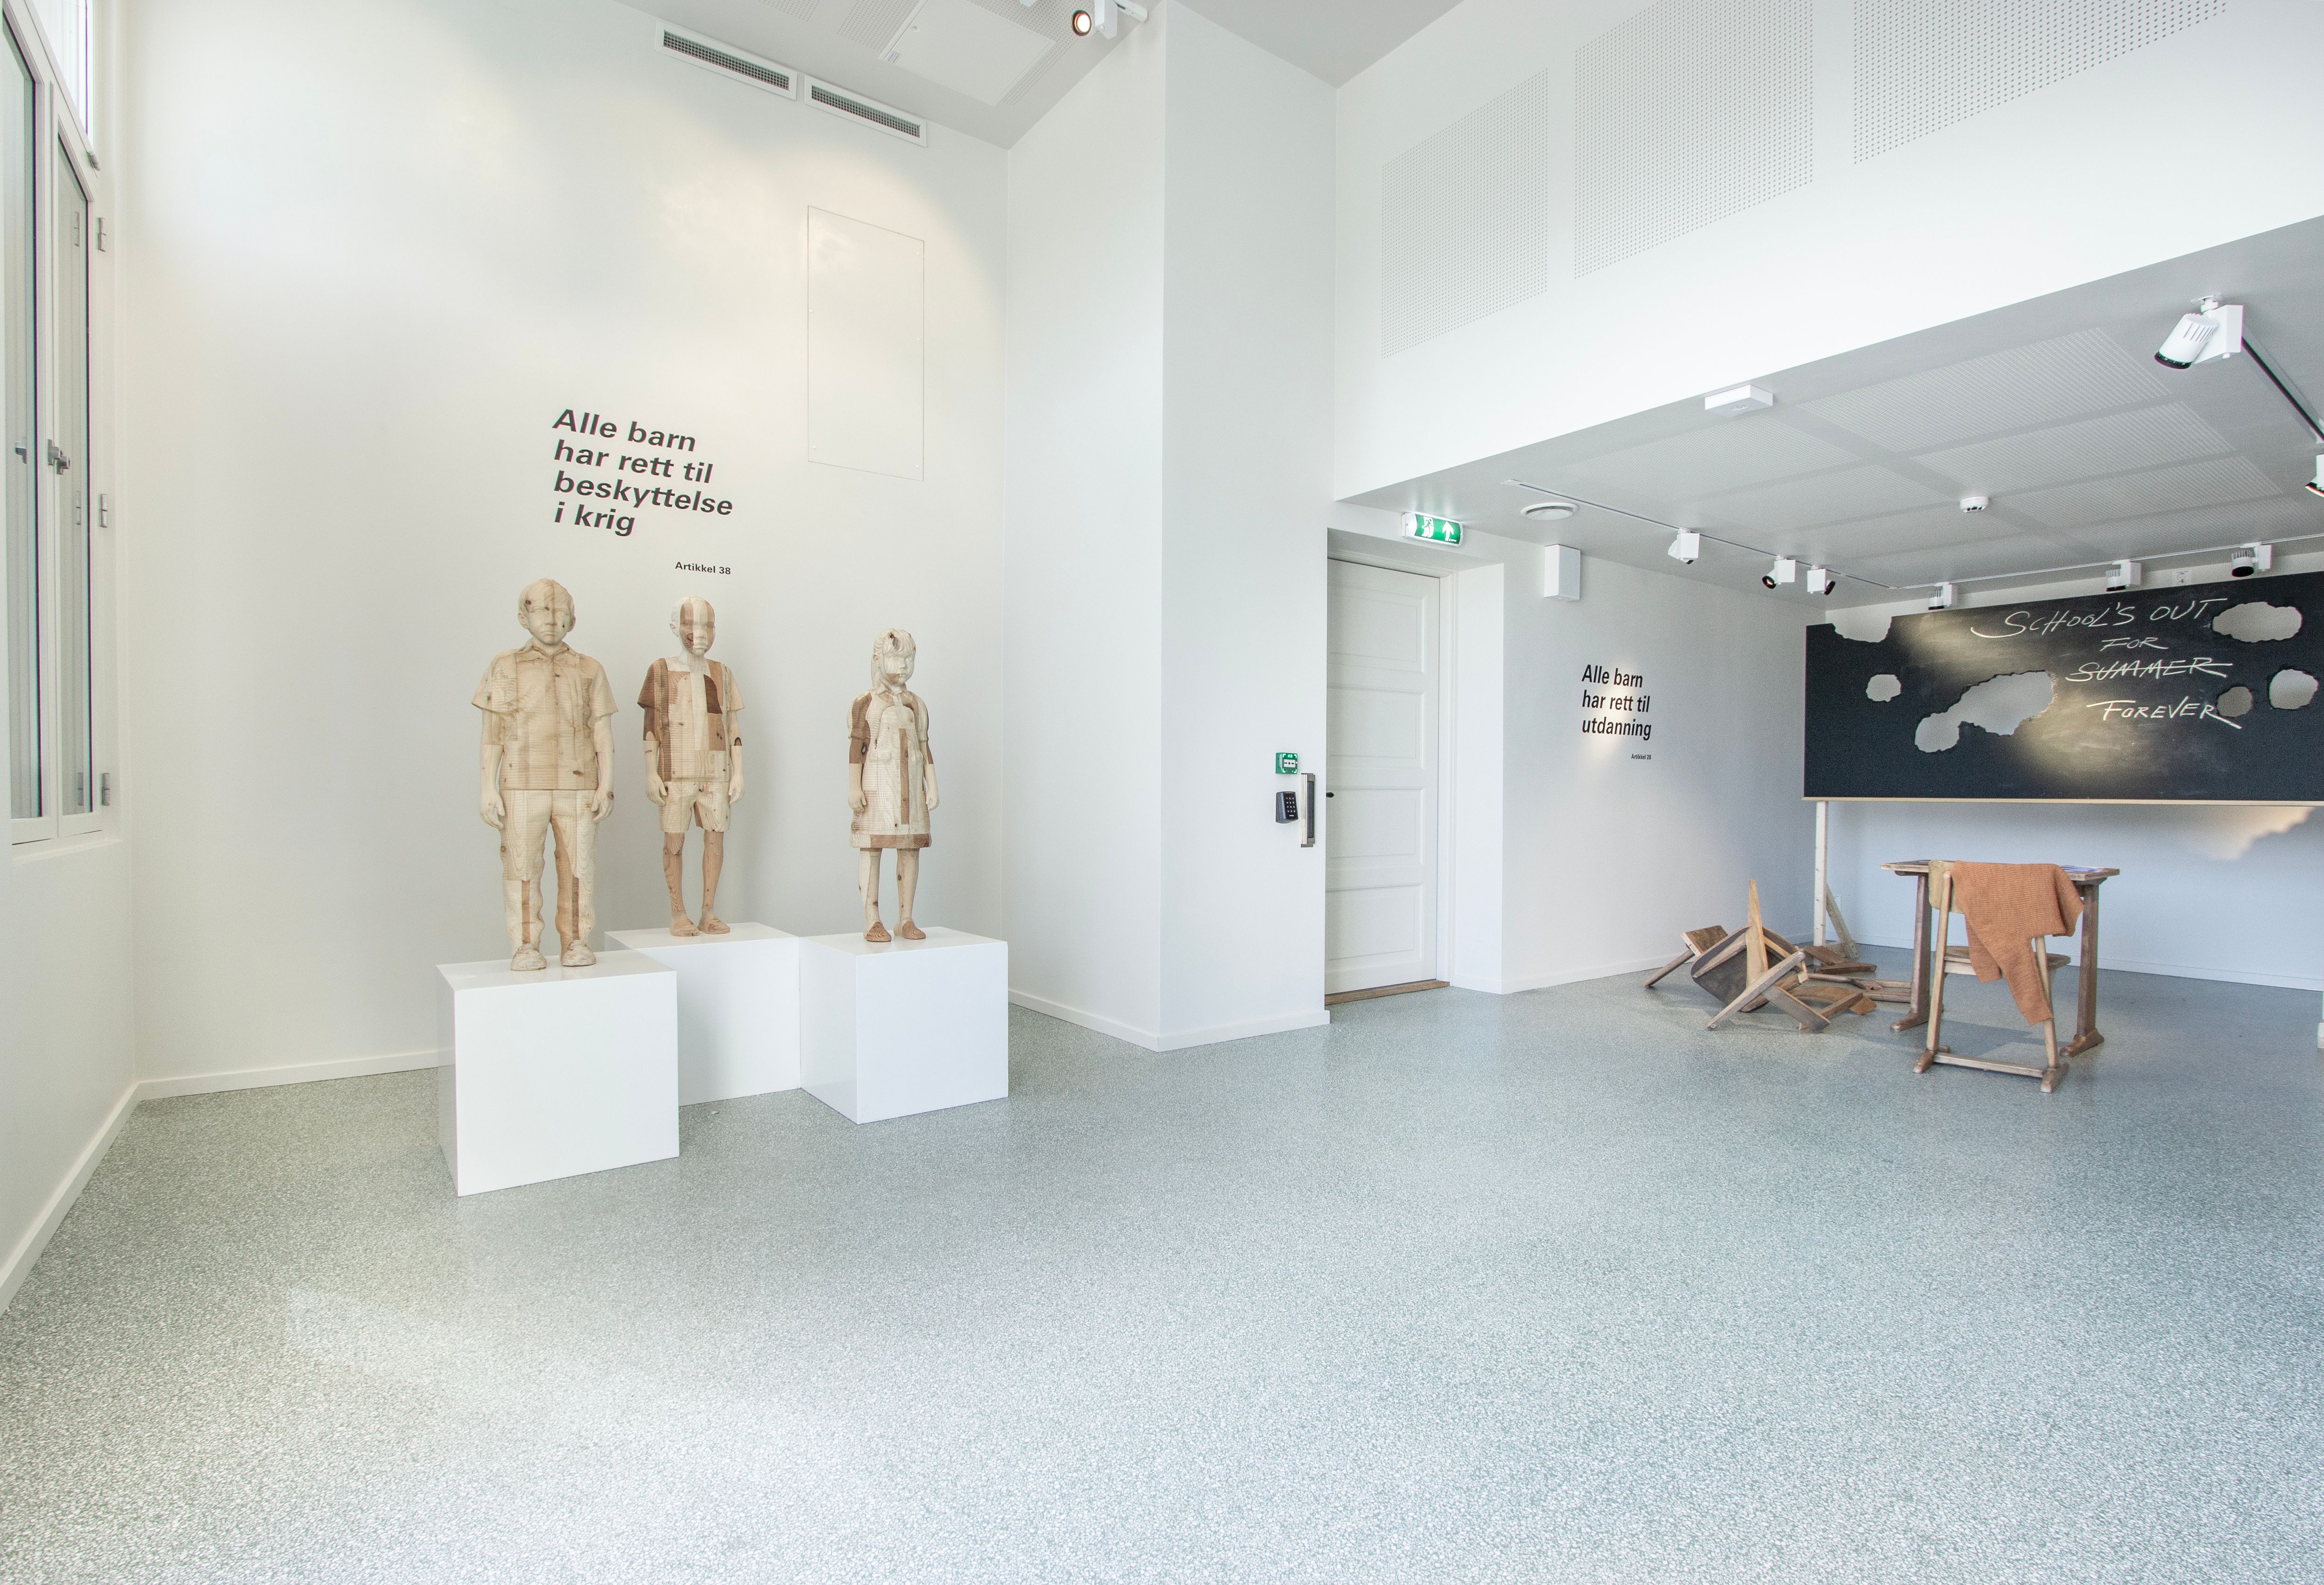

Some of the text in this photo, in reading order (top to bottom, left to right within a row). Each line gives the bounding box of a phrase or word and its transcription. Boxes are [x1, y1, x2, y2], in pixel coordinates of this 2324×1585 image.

[552, 409, 696, 452] Alle barn
[554, 439, 713, 483] har rett til
[554, 470, 733, 515] beskyttelse
[554, 501, 635, 536] i krig
[675, 562, 716, 574] Artikkel
[2150, 598, 2228, 621] OUT
[2100, 637, 2169, 652] FOR
[1581, 665, 1643, 687] Alle barn
[2065, 657, 2233, 682] SUMMER
[1582, 690, 1650, 713] har rett til
[2086, 696, 2242, 729] FOREVER
[1582, 717, 1652, 741] utdanning
